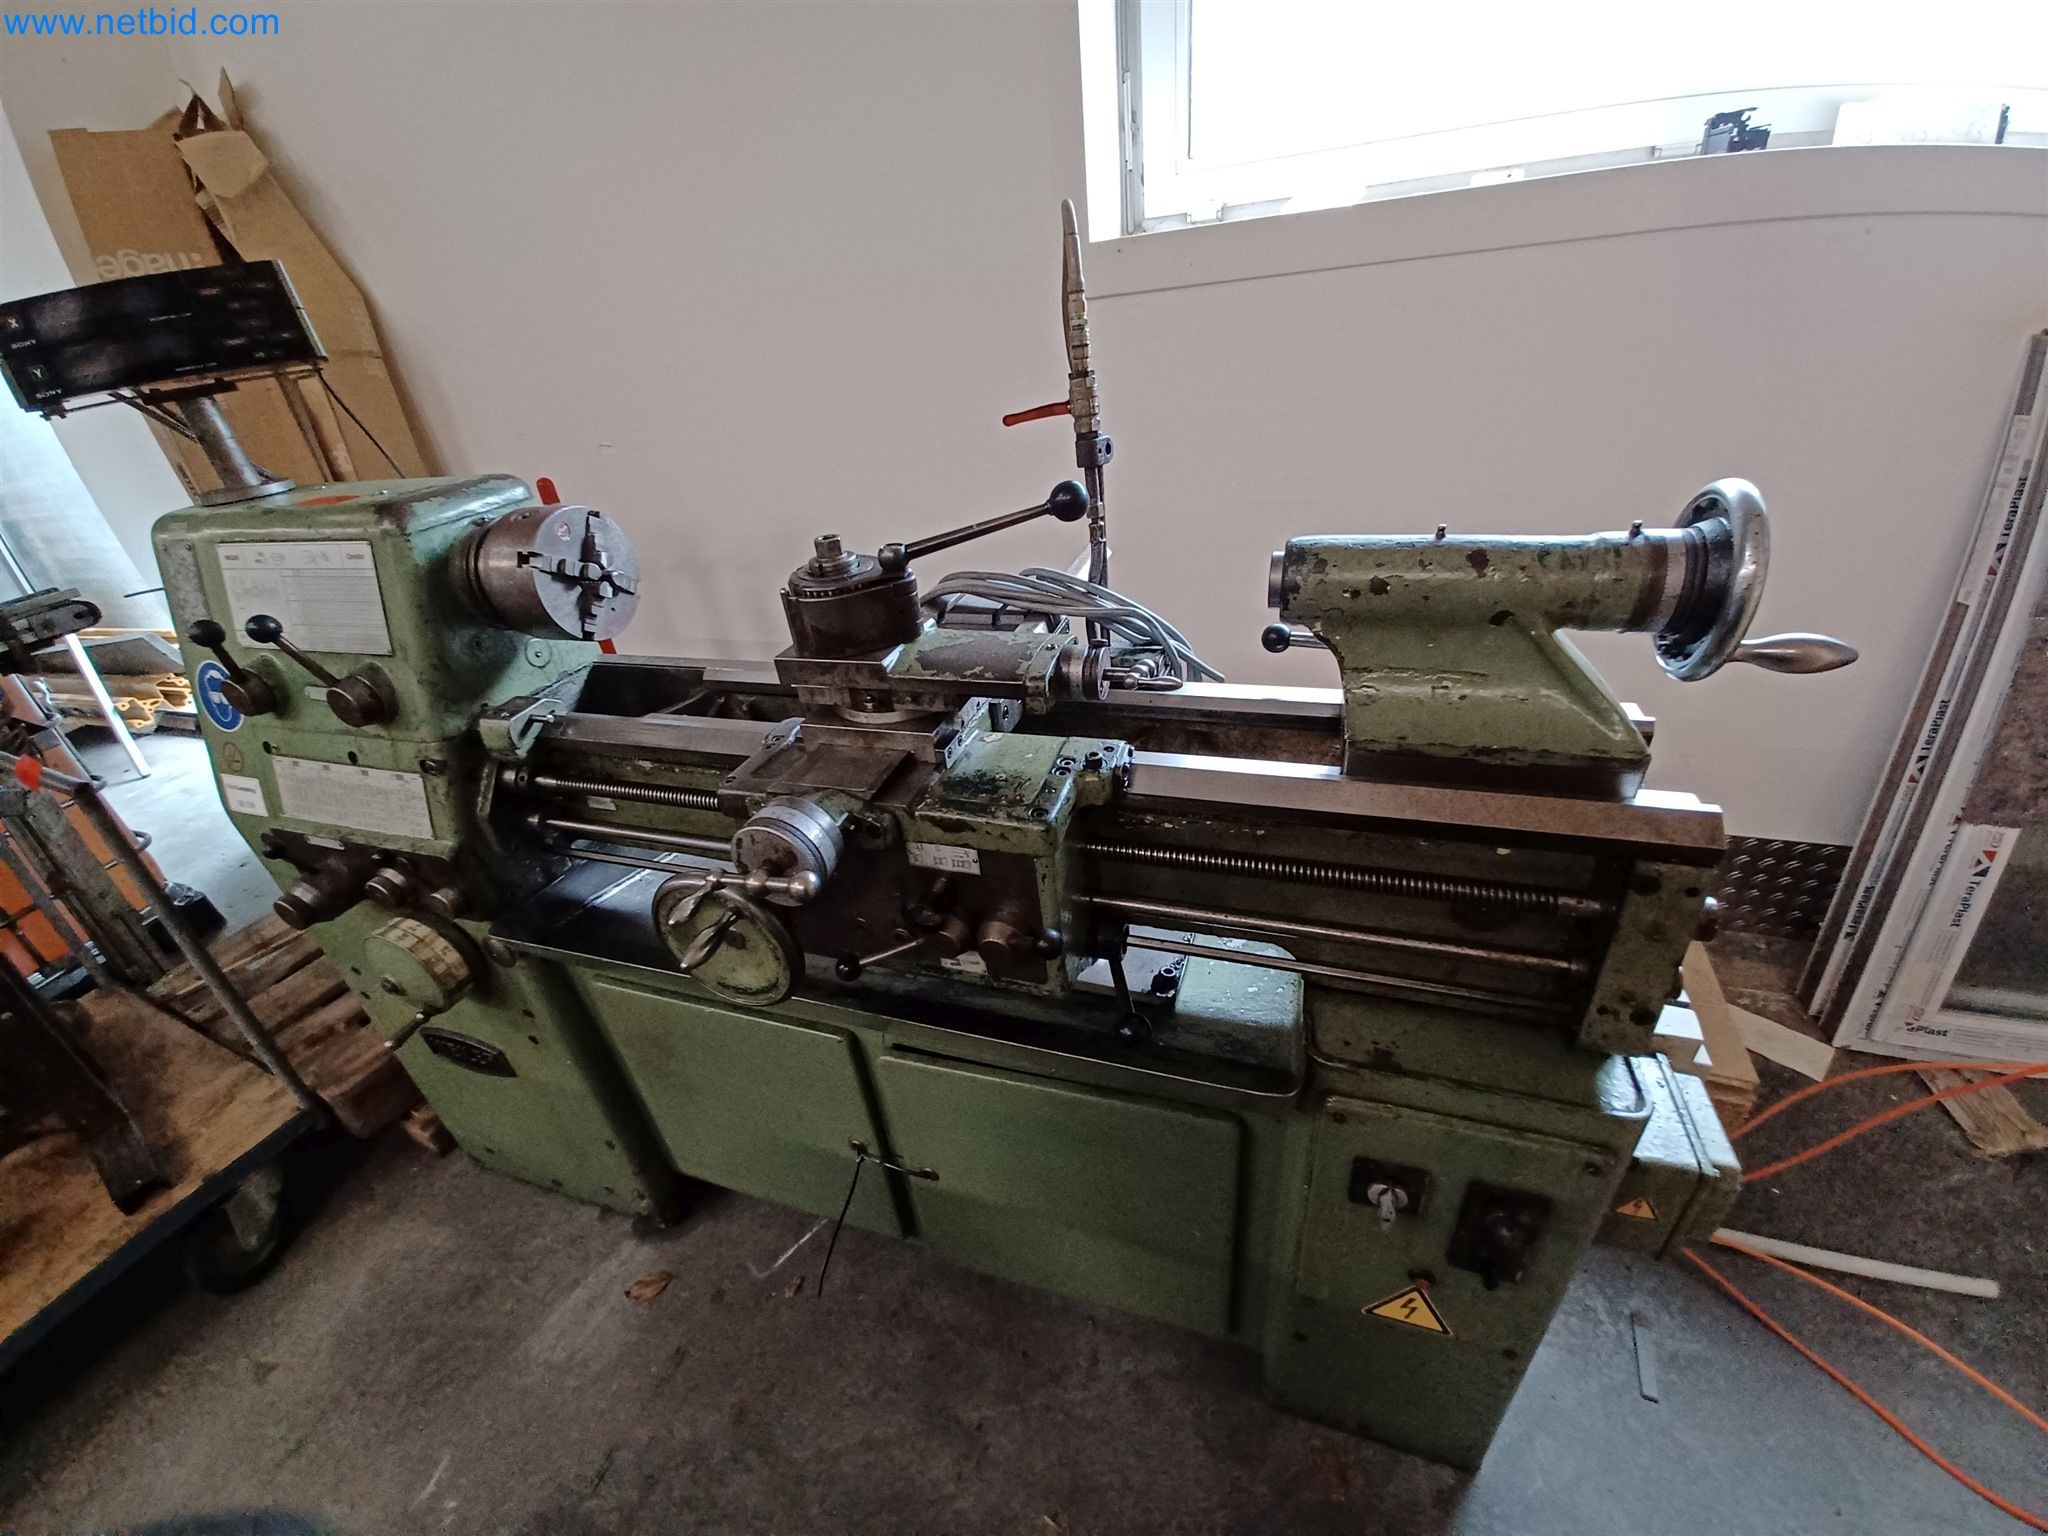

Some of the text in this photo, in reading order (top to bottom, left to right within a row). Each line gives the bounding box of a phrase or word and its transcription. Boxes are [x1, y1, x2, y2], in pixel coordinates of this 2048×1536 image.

[10, 338, 37, 350] SONY
[34, 387, 62, 400] SONY
[1921, 698, 1952, 751] TeraPlast
[1950, 879, 1981, 928] TeraPlast
